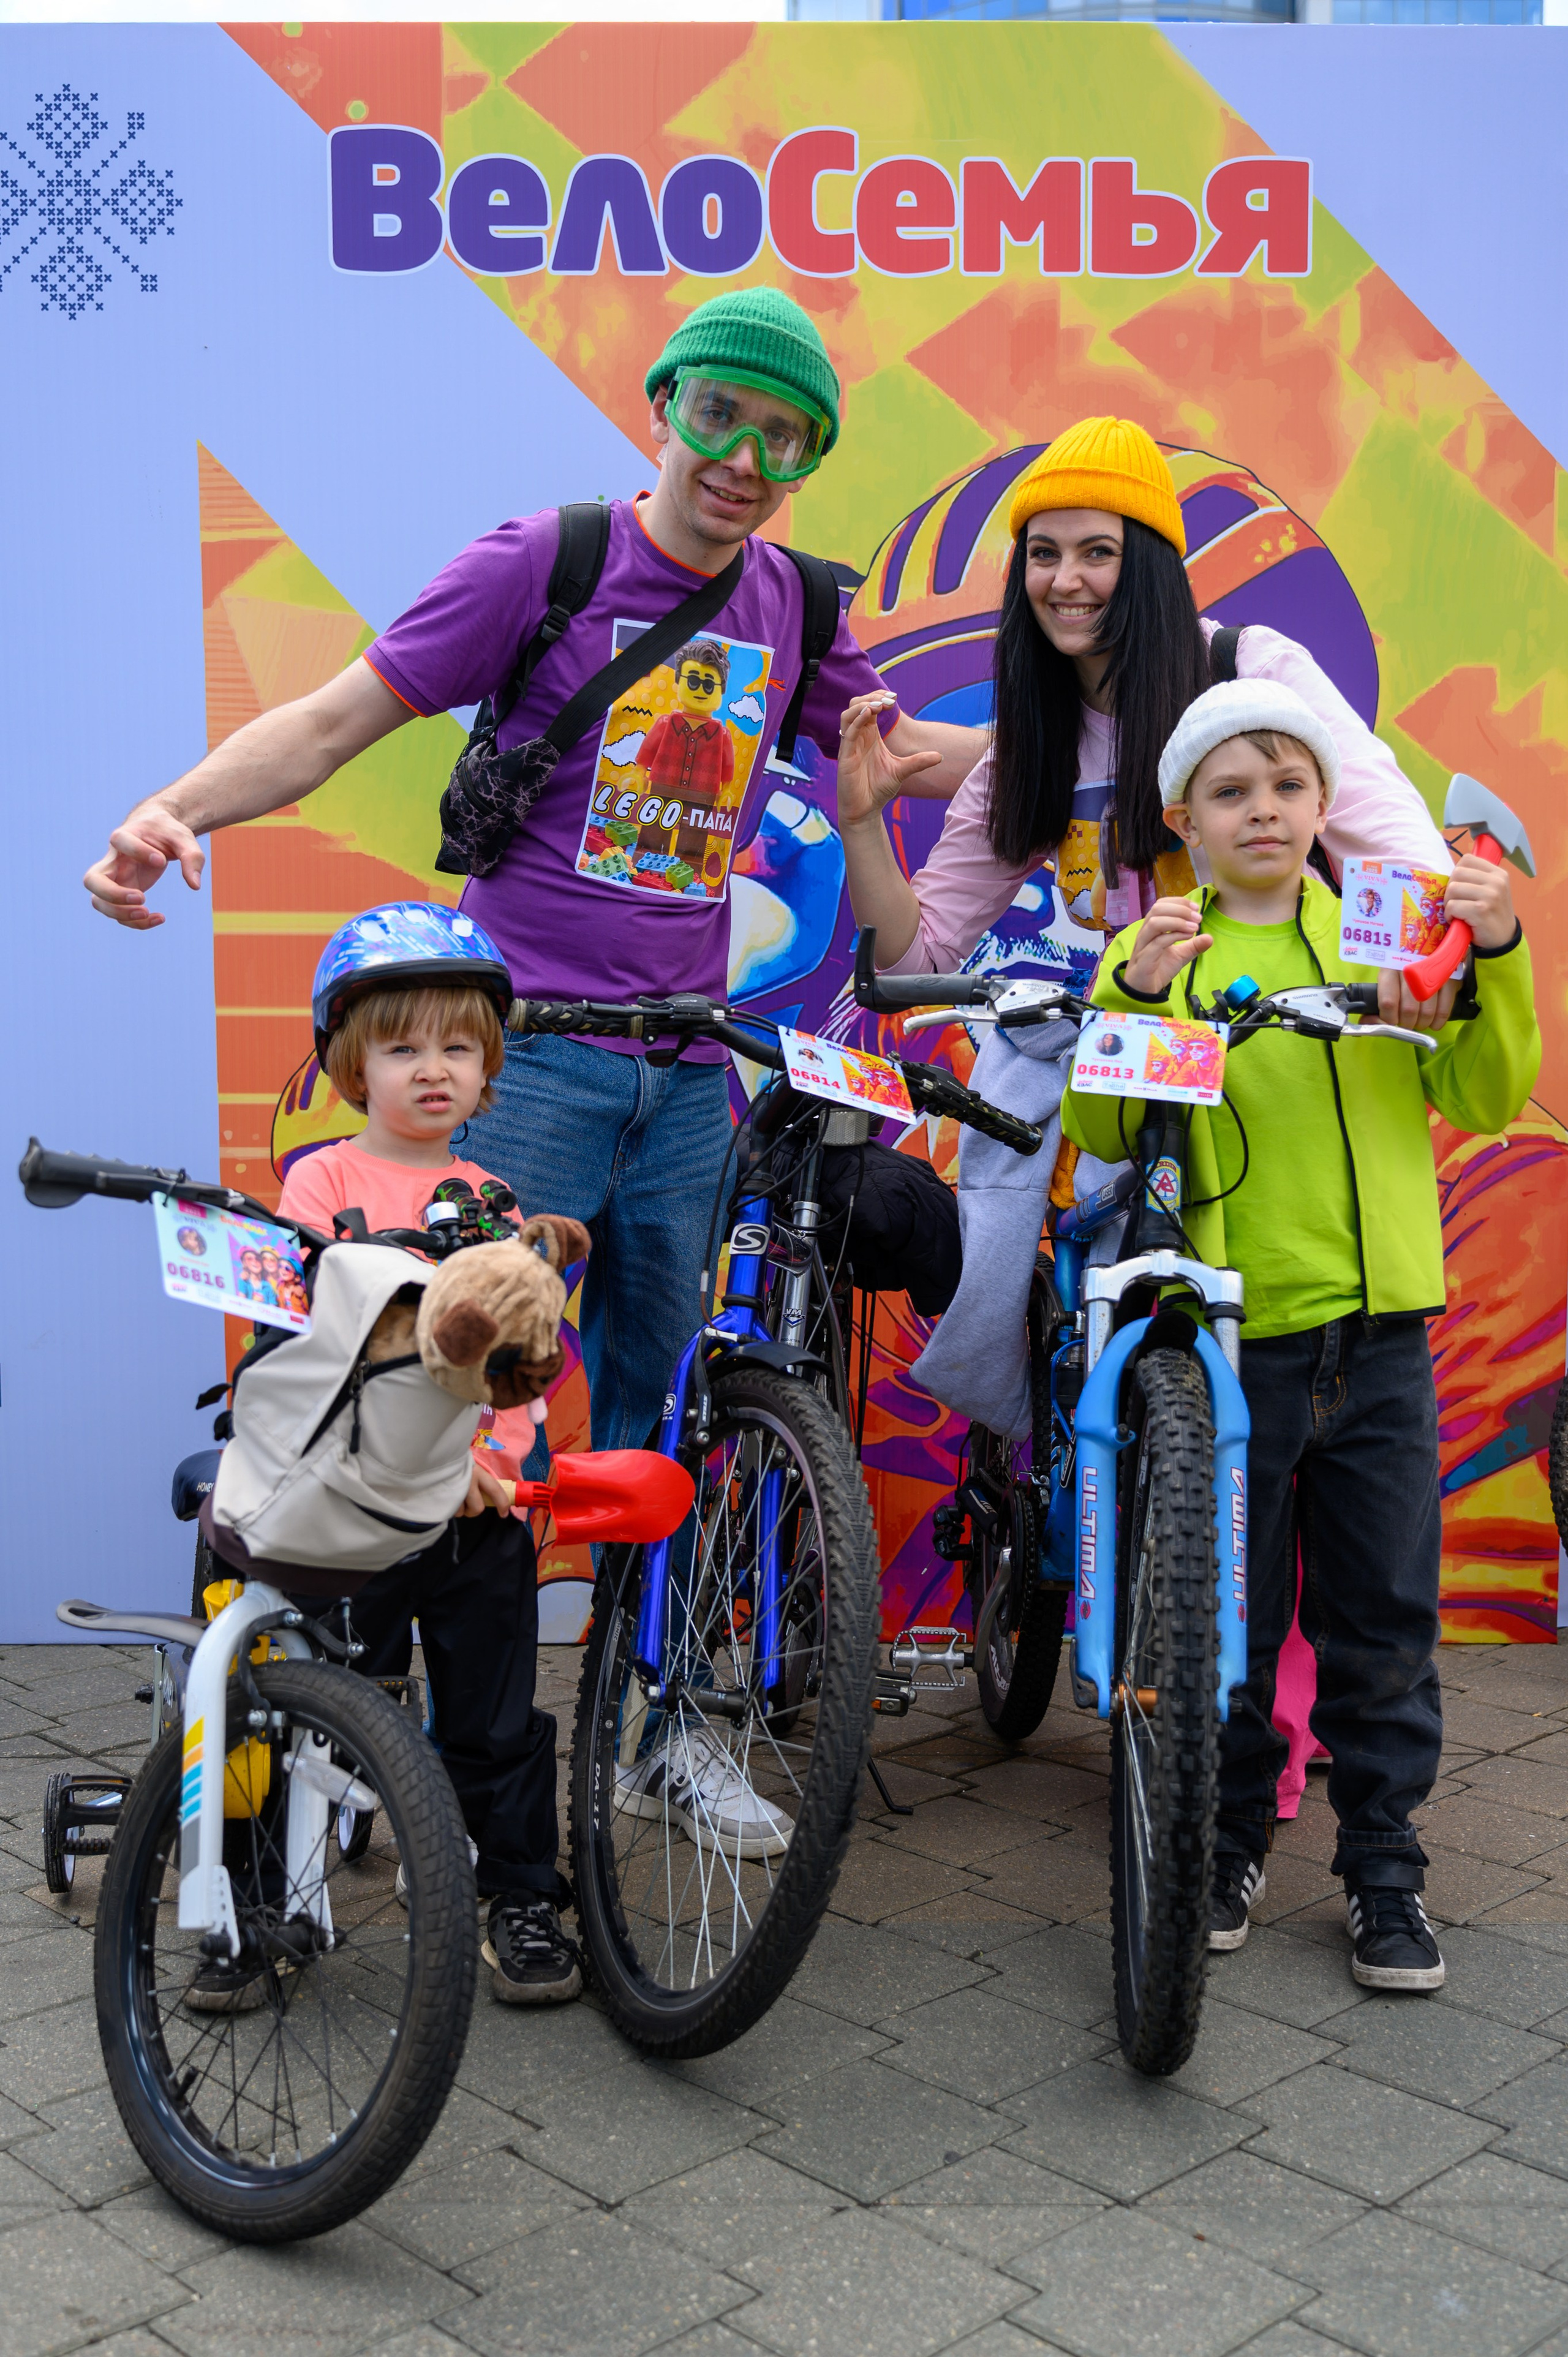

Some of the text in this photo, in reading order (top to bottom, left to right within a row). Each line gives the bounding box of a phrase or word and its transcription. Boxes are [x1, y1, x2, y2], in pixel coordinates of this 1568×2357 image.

[329, 125, 1313, 277] ВелоСемья
[1392, 870, 1437, 884] ВелоСемья
[1343, 927, 1392, 946] 06815
[1137, 1019, 1191, 1030] ВелоСемья
[791, 1068, 841, 1090] 06814
[1076, 1064, 1134, 1079] 06813
[167, 1262, 226, 1289] 06816
[1080, 1466, 1097, 1600] ULTIMA
[1230, 1466, 1245, 1602] ULTIMA
